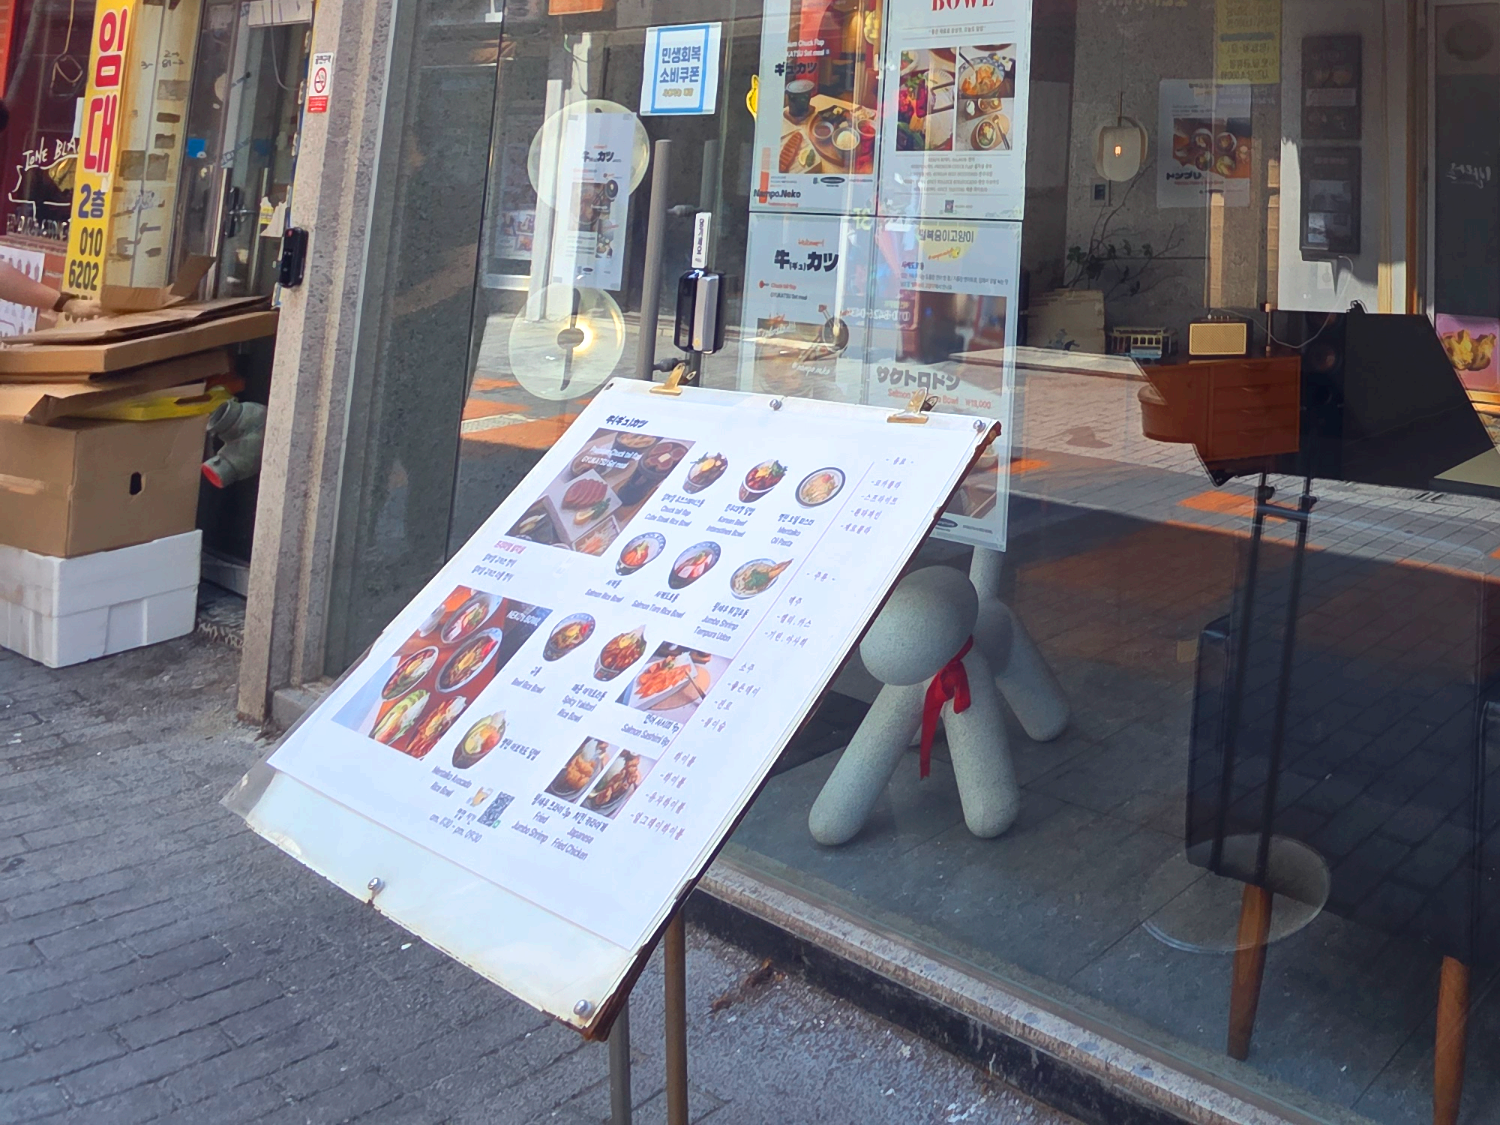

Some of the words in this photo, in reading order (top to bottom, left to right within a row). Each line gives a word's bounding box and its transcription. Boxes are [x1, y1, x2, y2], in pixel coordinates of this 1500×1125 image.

[661, 45, 702, 64] 민생회복
[659, 65, 700, 84] 소비쿠폰
[84, 8, 128, 174] 임대
[78, 183, 106, 219] 2층
[79, 227, 103, 257] 010
[68, 260, 100, 291] 6202
[510, 820, 531, 835] Jumbo
[528, 827, 549, 845] Shrimp
[566, 826, 594, 844] Japanese
[550, 837, 569, 851] Fried
[564, 843, 588, 861] Chicken
